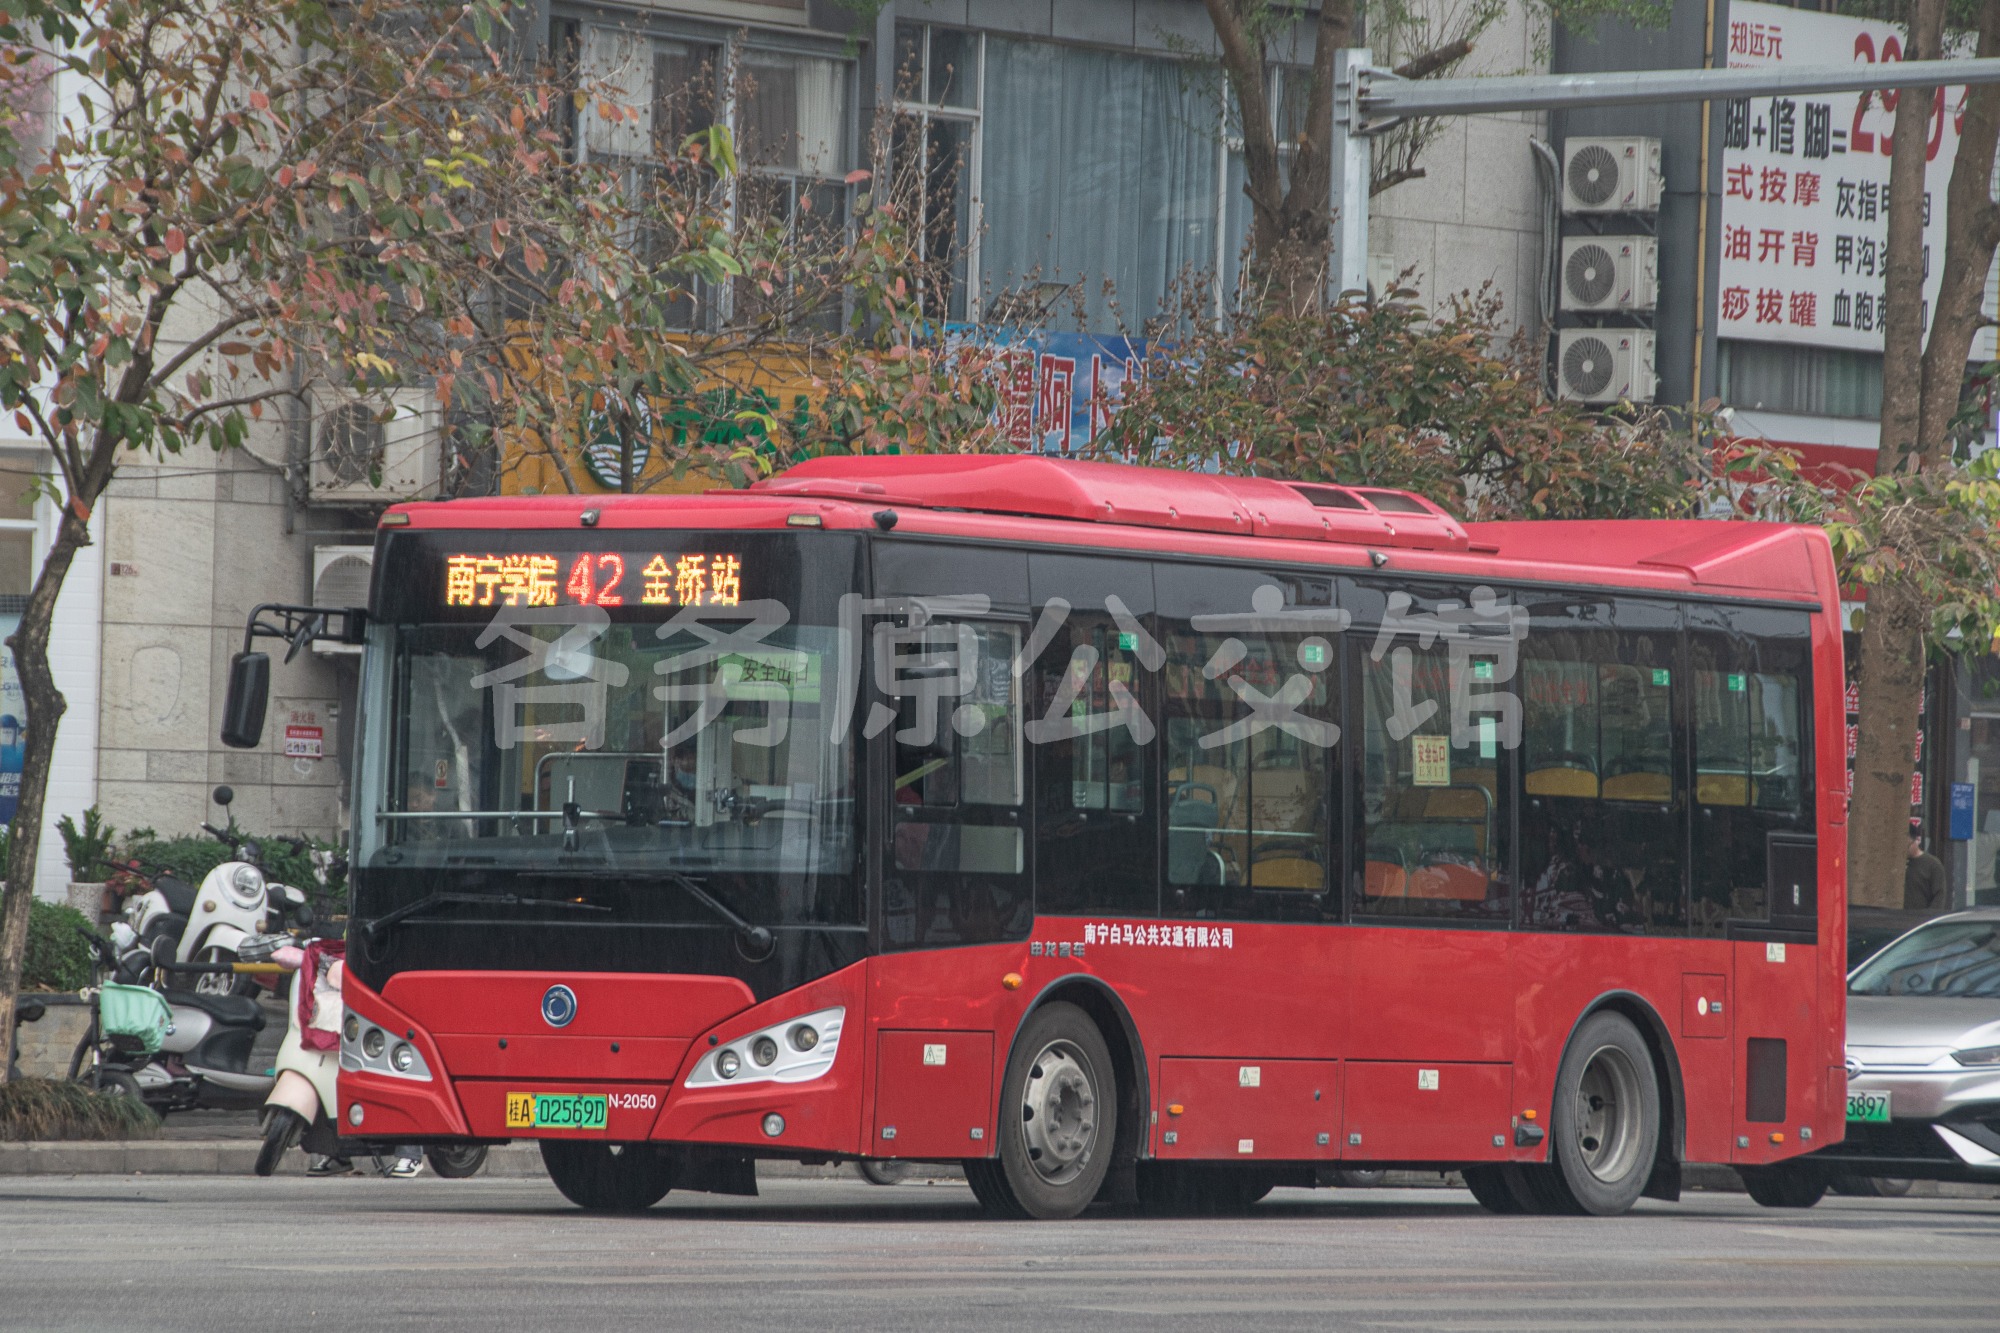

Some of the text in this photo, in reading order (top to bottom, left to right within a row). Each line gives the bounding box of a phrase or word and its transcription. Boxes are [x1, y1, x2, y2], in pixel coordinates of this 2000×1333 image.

[1730, 21, 1782, 60] 郑远元
[1726, 162, 1821, 207] 式按摩
[1724, 223, 1819, 268] 油开背
[1722, 285, 1818, 328] 痧拔罐
[447, 552, 740, 606] 南宁学院 42 金桥站
[743, 656, 809, 684] 安全出口
[1417, 743, 1446, 763] 安全出口
[1084, 922, 1233, 949] 南宁白马公共交通有限公司
[608, 1093, 656, 1109] N-2050
